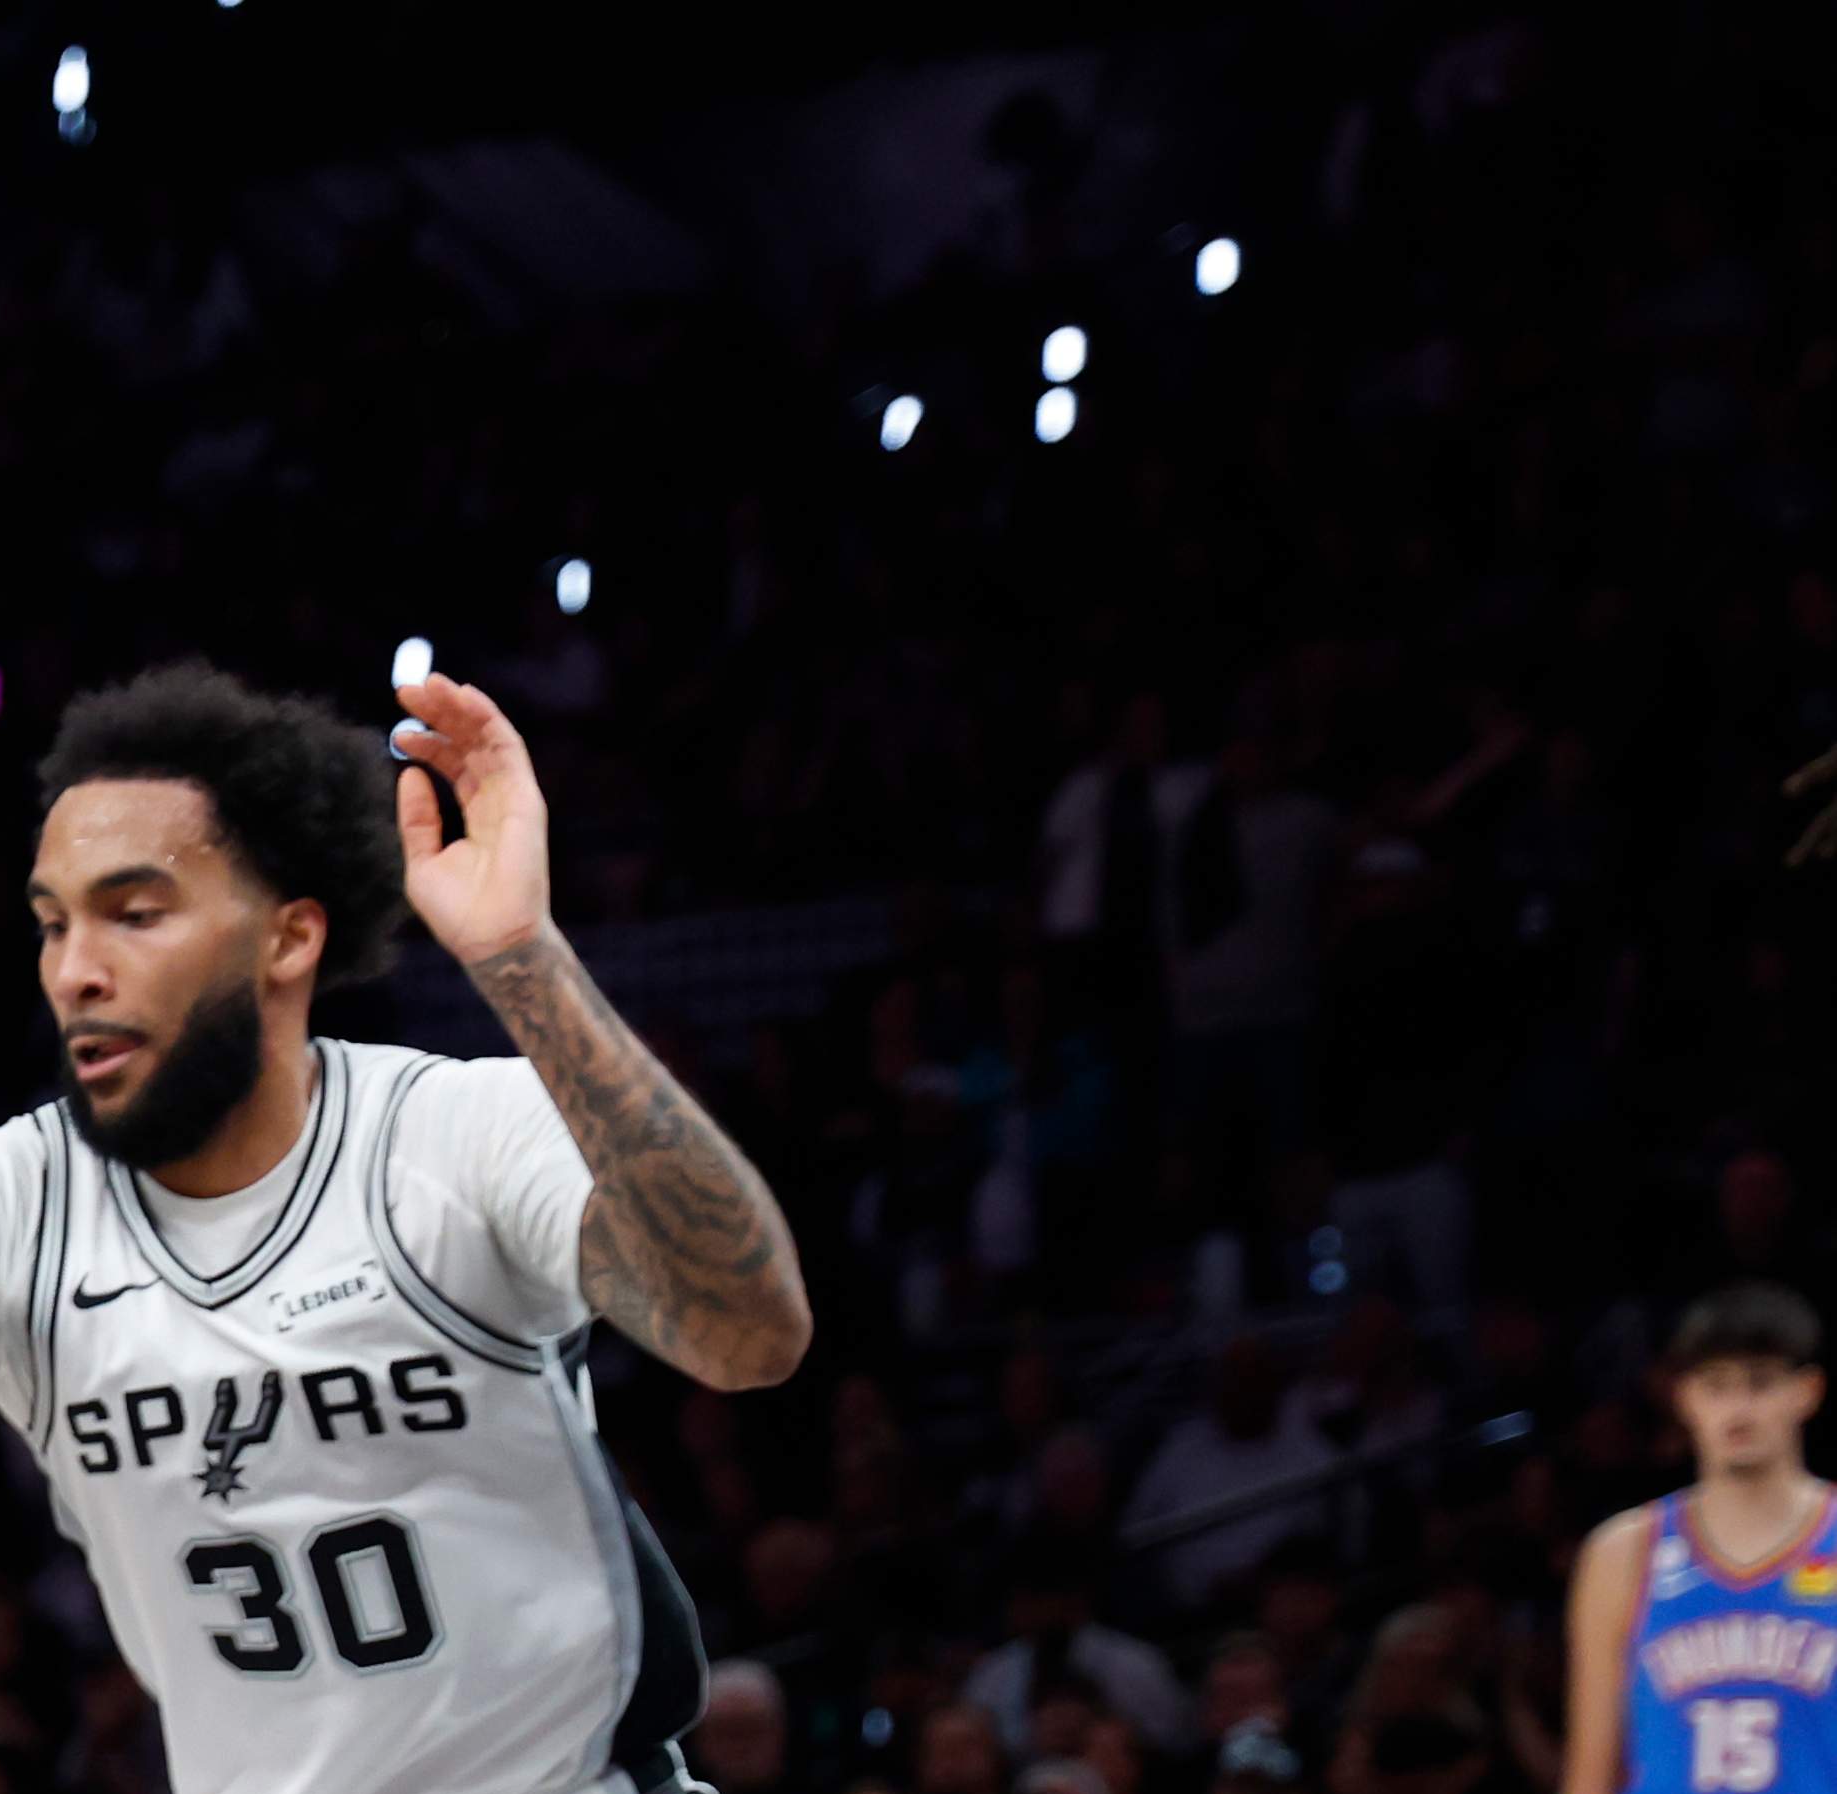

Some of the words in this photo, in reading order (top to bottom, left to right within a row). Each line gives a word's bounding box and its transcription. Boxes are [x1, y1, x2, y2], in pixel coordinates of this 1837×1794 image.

[284, 1276, 368, 1317] LEDGER
[66, 1354, 469, 1501] SPURS
[178, 1509, 446, 1678] 30
[1685, 1698, 1780, 1794] 15
